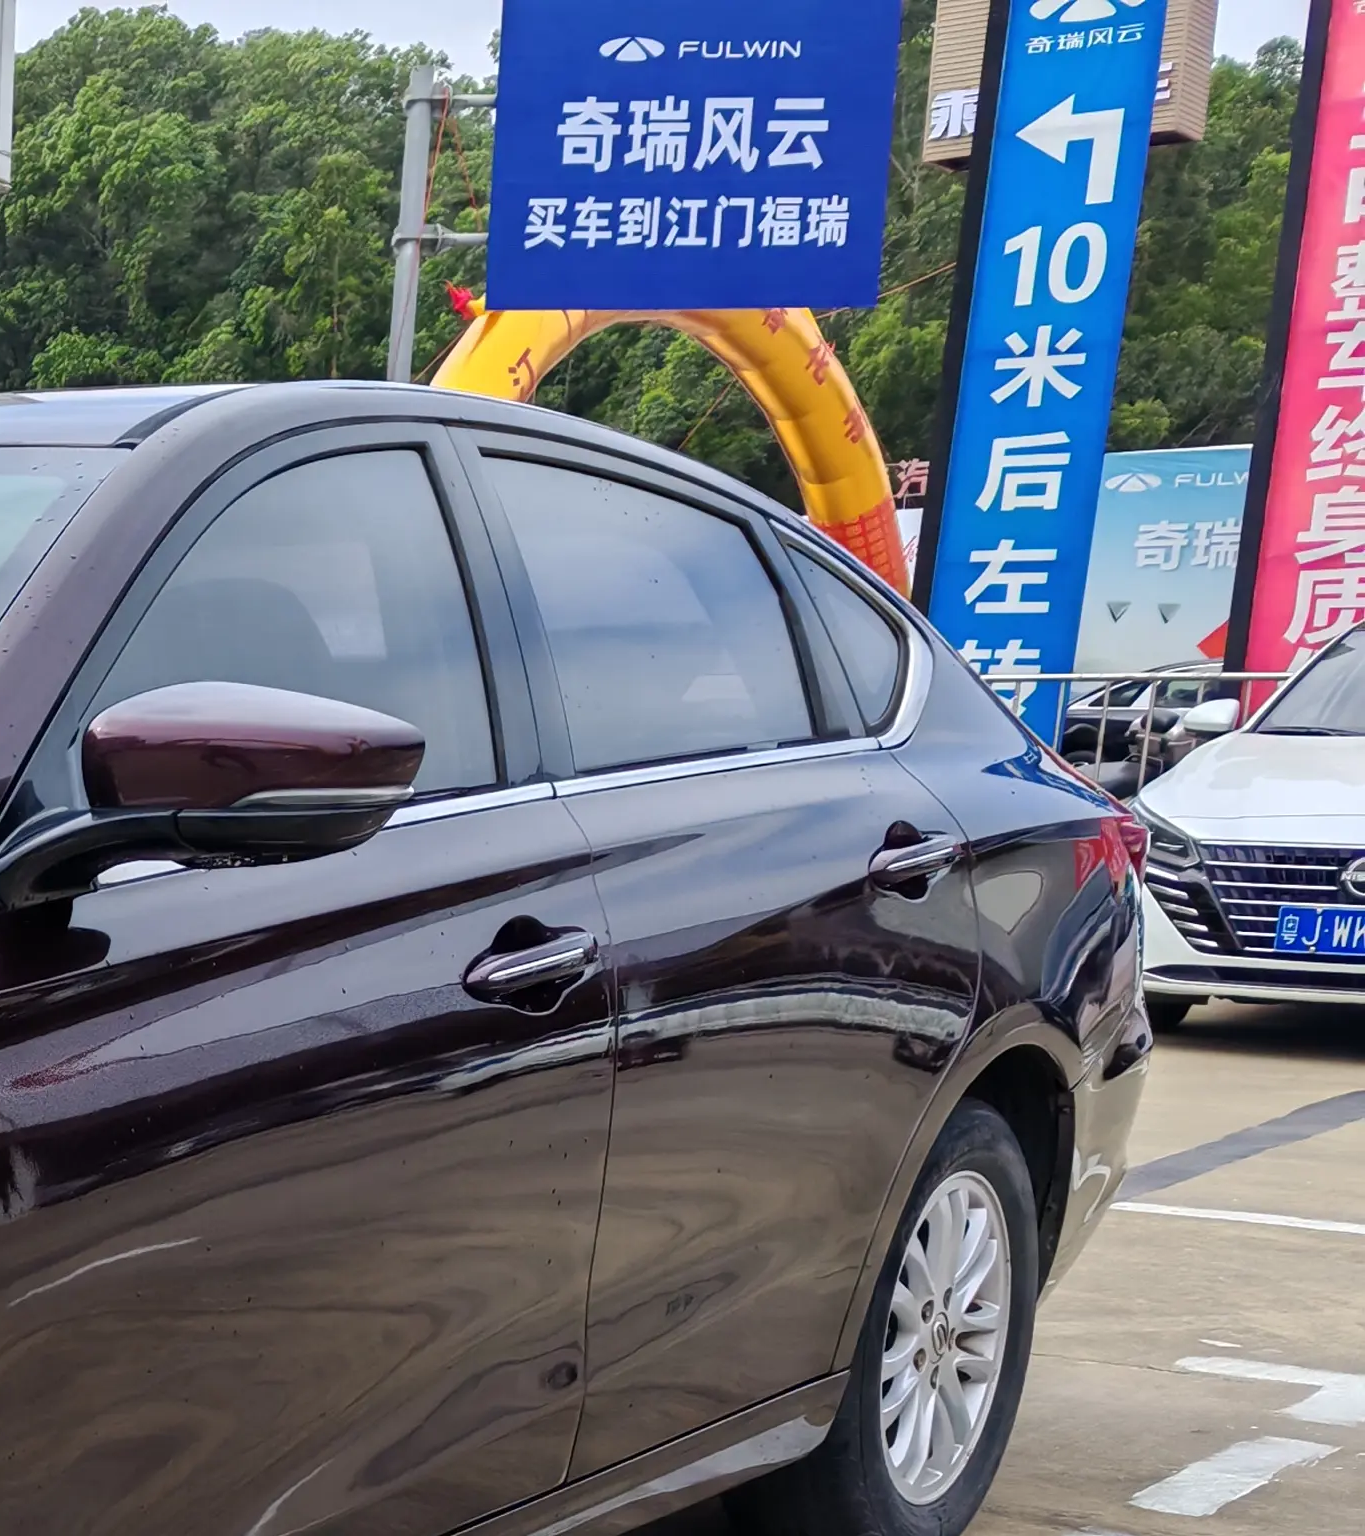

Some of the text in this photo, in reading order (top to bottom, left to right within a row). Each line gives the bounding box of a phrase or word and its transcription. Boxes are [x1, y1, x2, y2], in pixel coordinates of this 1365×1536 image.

[677, 39, 802, 60] FULWIN
[1025, 22, 1146, 55] 奇瑞风云
[555, 96, 830, 173] 奇瑞风云
[523, 194, 851, 250] 买车到江门福瑞
